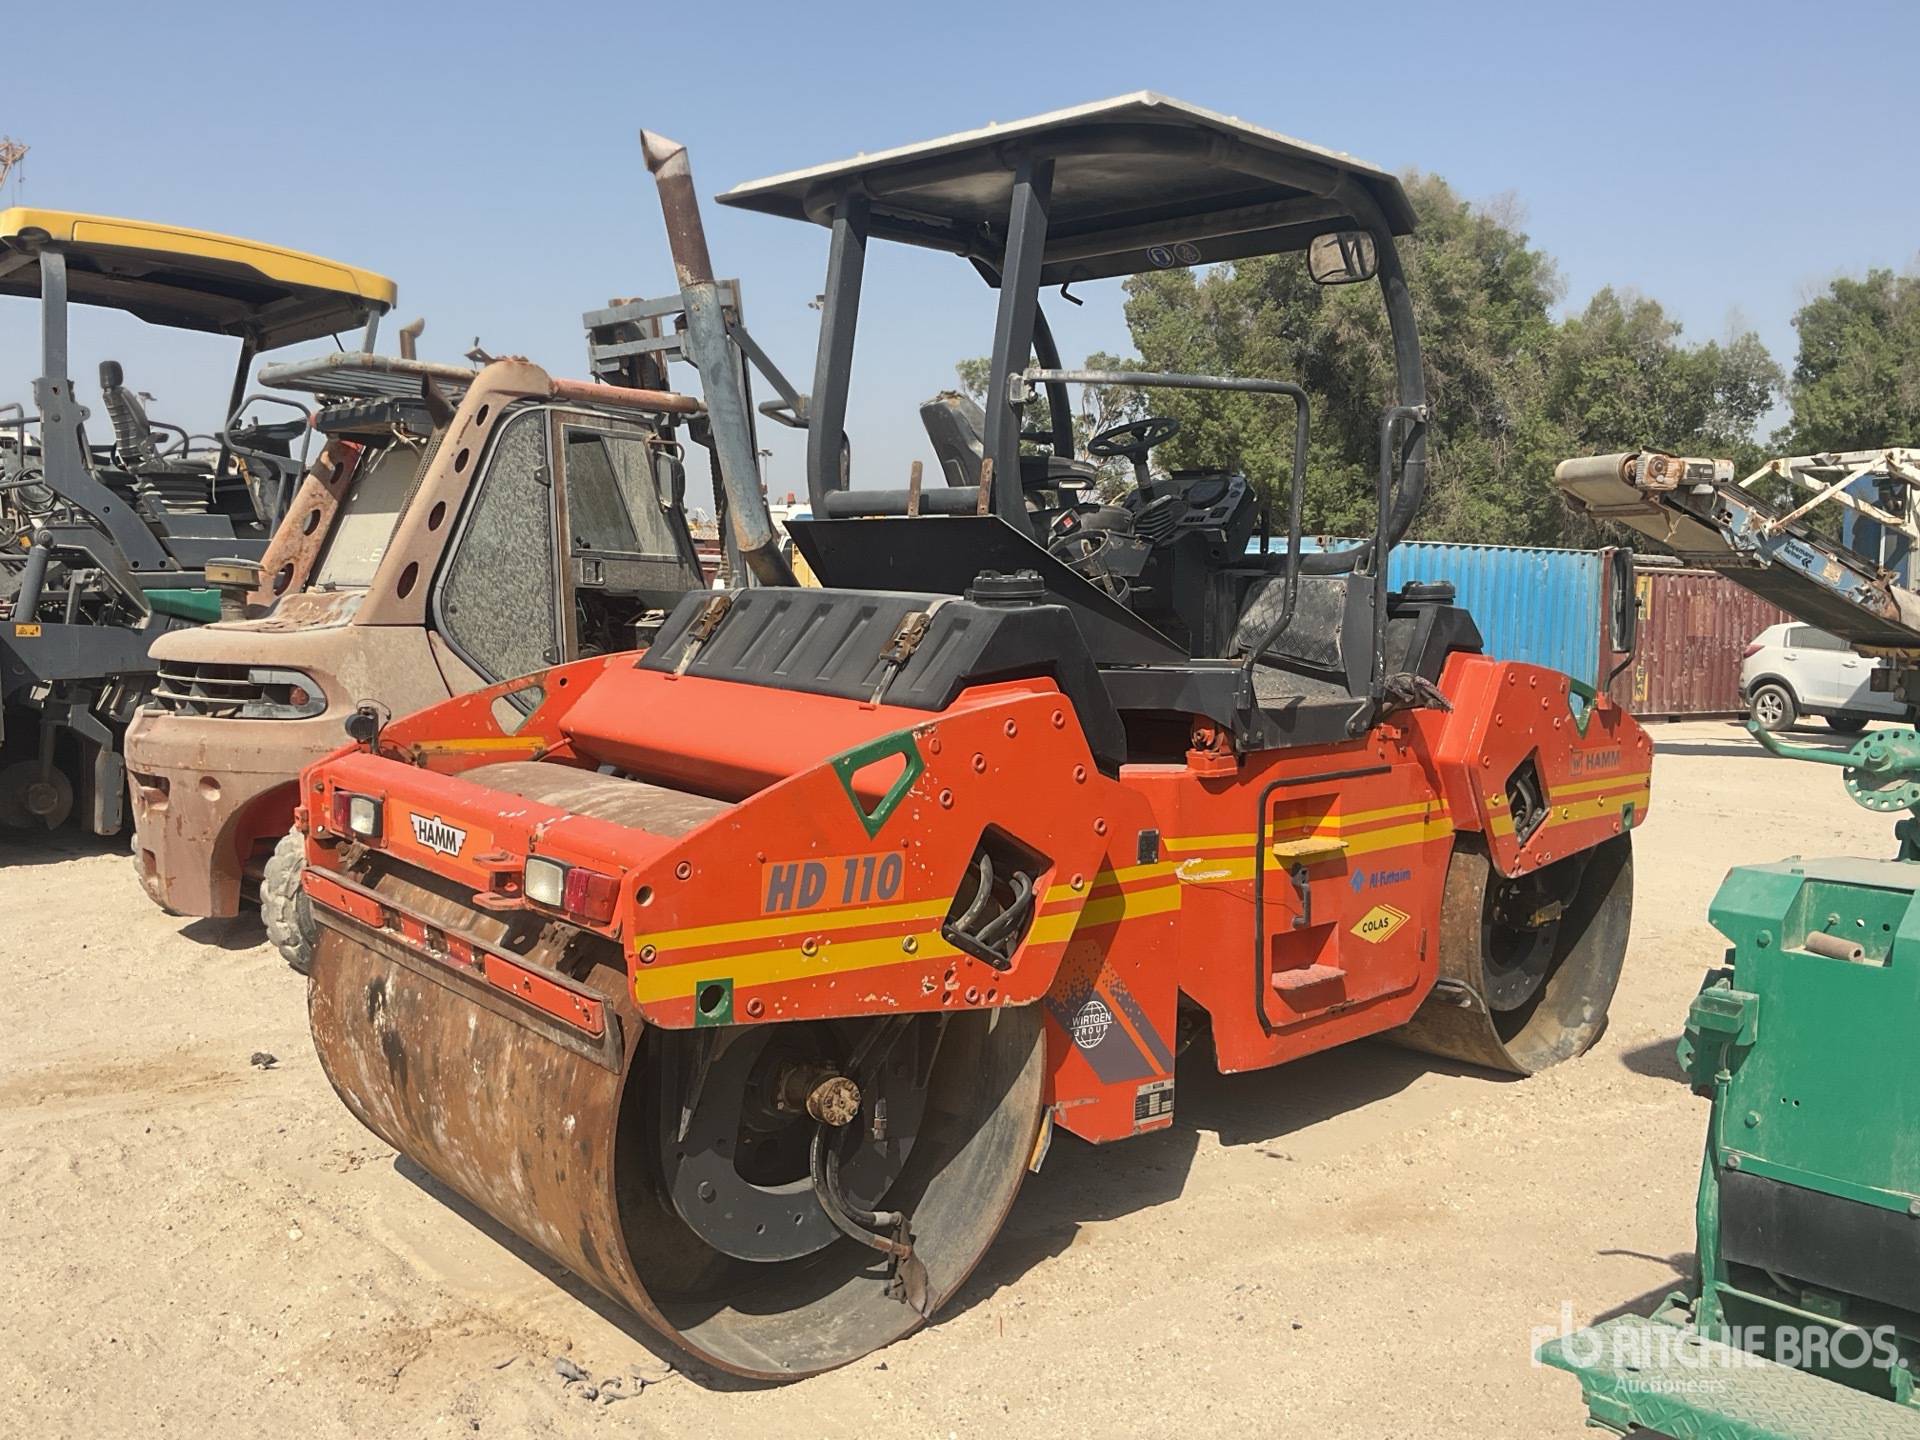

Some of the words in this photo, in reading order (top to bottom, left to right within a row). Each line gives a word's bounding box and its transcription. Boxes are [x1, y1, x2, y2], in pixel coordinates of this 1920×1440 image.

[1586, 750, 1620, 770] HAMM
[418, 819, 457, 853] HAMM
[765, 861, 827, 913] HD
[842, 852, 903, 904] 110
[1369, 868, 1411, 889] Al-Futtaim
[1362, 917, 1389, 933] COLAS
[1072, 1011, 1112, 1027] WIRTGEN
[1074, 1024, 1108, 1037] GROUP
